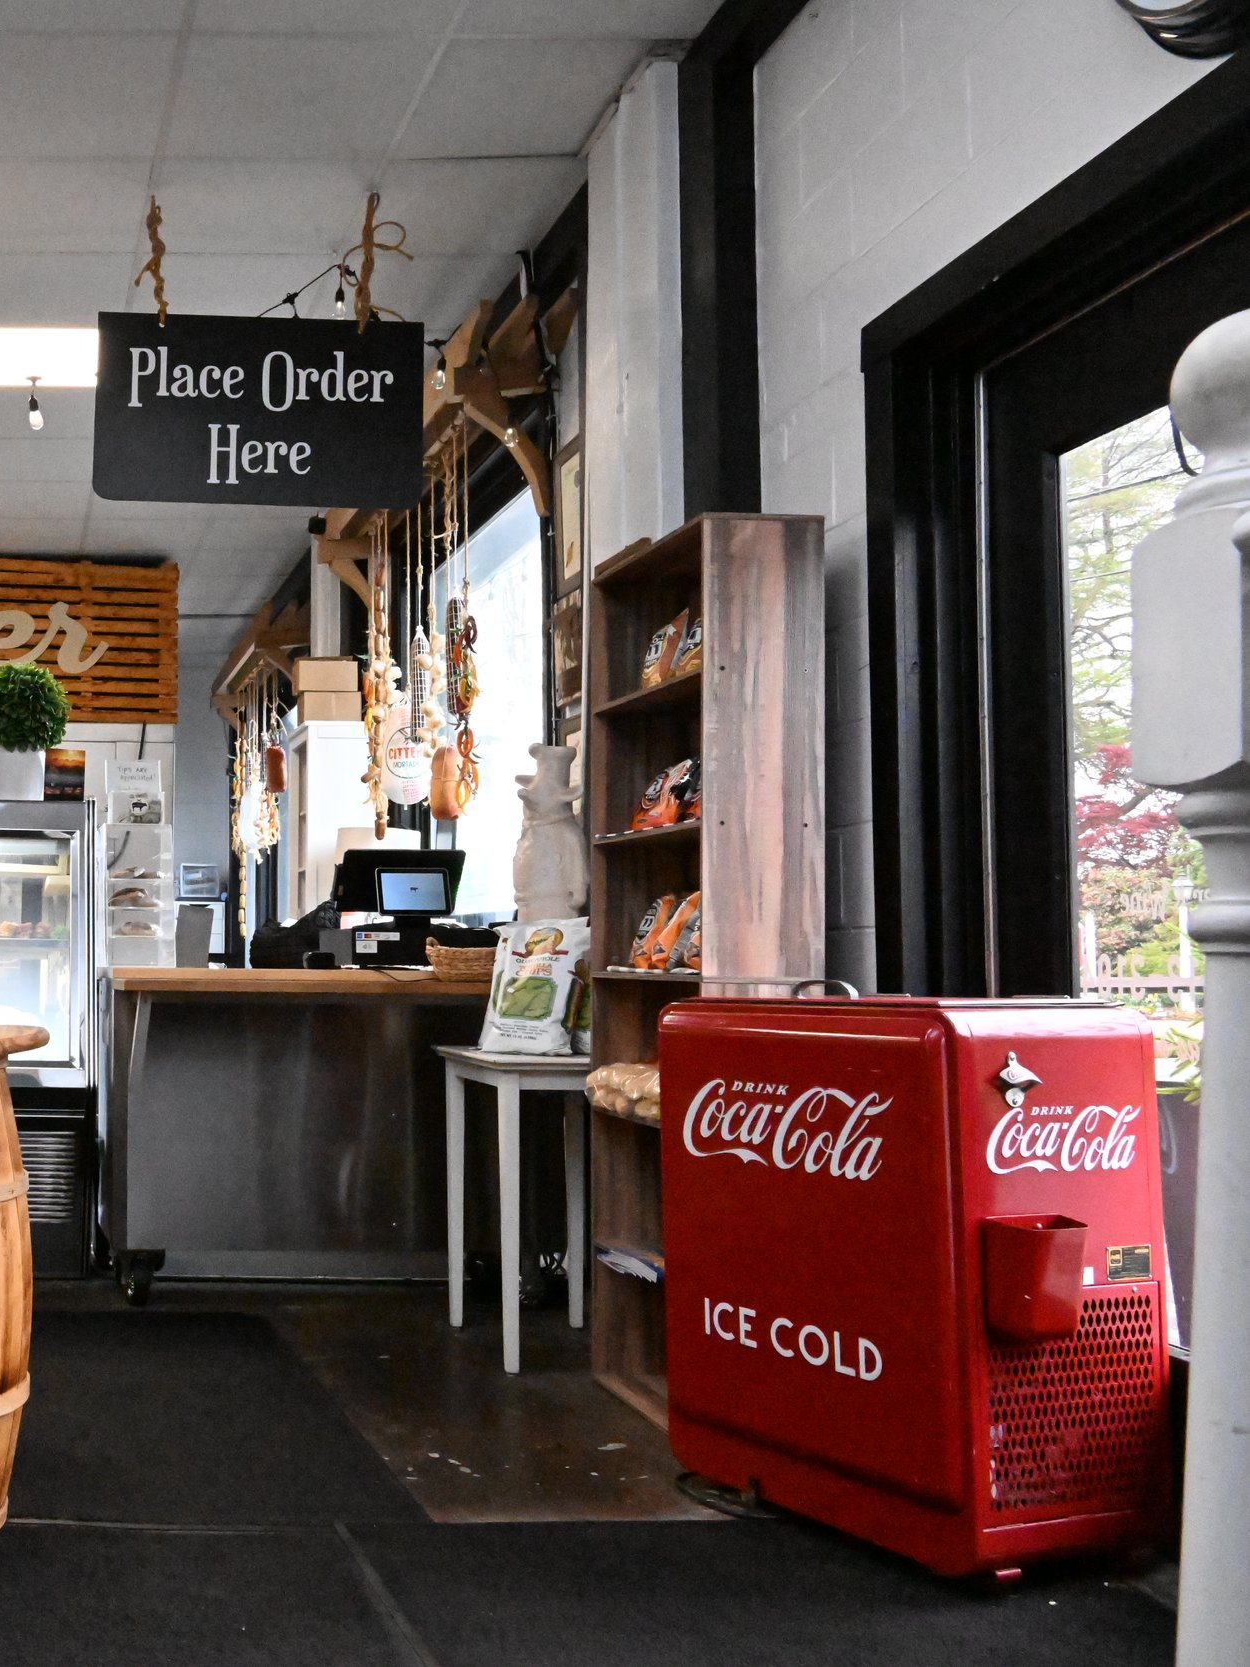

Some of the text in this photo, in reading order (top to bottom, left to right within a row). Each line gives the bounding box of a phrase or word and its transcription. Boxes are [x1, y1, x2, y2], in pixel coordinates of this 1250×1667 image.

[127, 346, 395, 412] Place Order
[206, 423, 312, 485] Here
[731, 1079, 791, 1097] DRINK
[1030, 1104, 1075, 1117] DRINK
[682, 1078, 895, 1182] Coca-Cola
[986, 1105, 1142, 1175] Coca-Cola
[703, 1296, 758, 1350] ICE
[770, 1316, 884, 1382] COLD
